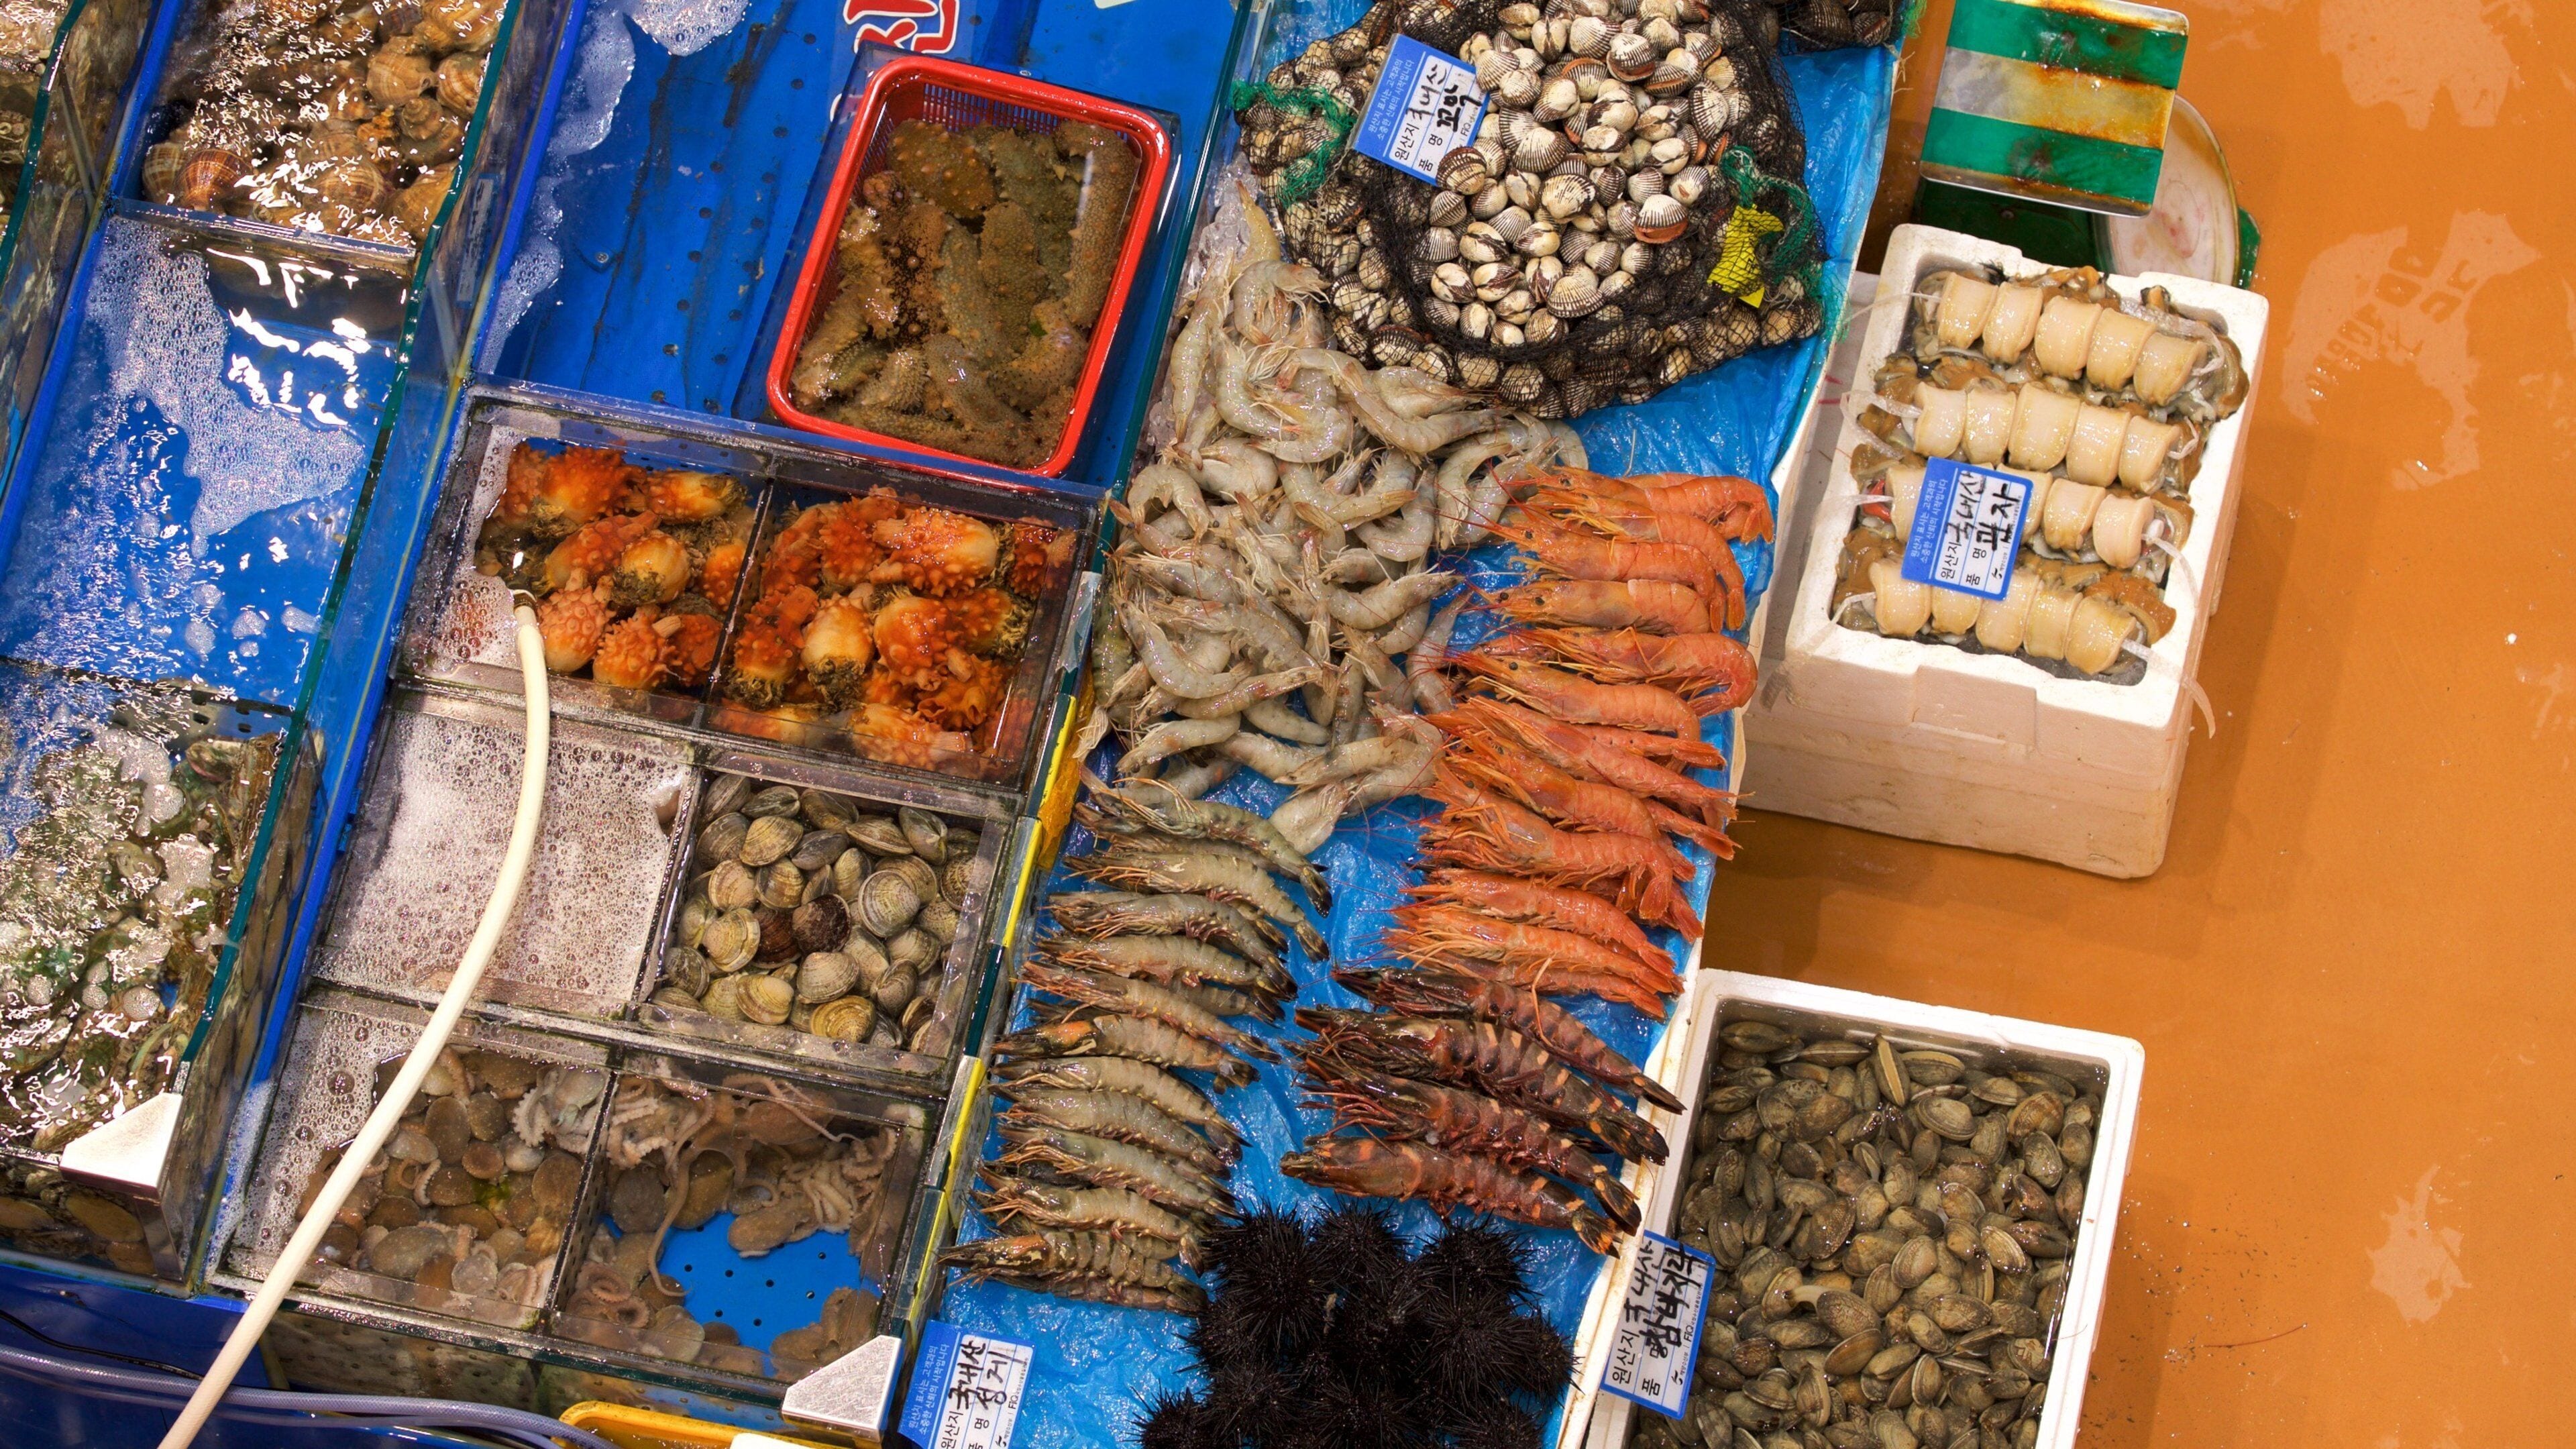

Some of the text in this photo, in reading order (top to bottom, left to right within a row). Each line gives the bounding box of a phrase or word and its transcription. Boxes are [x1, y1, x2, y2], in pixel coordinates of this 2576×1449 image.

[1368, 59, 1403, 132] 원산지 표시는 고객과의
[1377, 60, 1414, 140] 소중한 신뢰의 시작입니다
[1418, 159, 1434, 172] 품
[1428, 133, 1443, 146] 명
[1437, 85, 1483, 132] 꼬막
[1395, 123, 1419, 160] 원산지
[1911, 480, 1937, 557] 원산지 표시는 고객과의
[1921, 479, 1948, 564] 소중한 신뢰의 시작입니다
[1941, 471, 1986, 579] 원산지 국내산
[1976, 483, 2021, 551] 관자
[1966, 574, 1980, 586] 품
[1972, 547, 1986, 559] 명
[908, 1346, 938, 1428] 원산지 표시는 고객과의
[919, 1344, 950, 1435] 소중한 신뢰의 시작입니다
[948, 1340, 986, 1409] 국내산
[976, 1351, 1027, 1409] 성게
[1612, 1329, 1640, 1384] 원산지
[1642, 1378, 1660, 1396] 품
[941, 1411, 963, 1449] 원산지
[974, 1417, 989, 1430] 명
